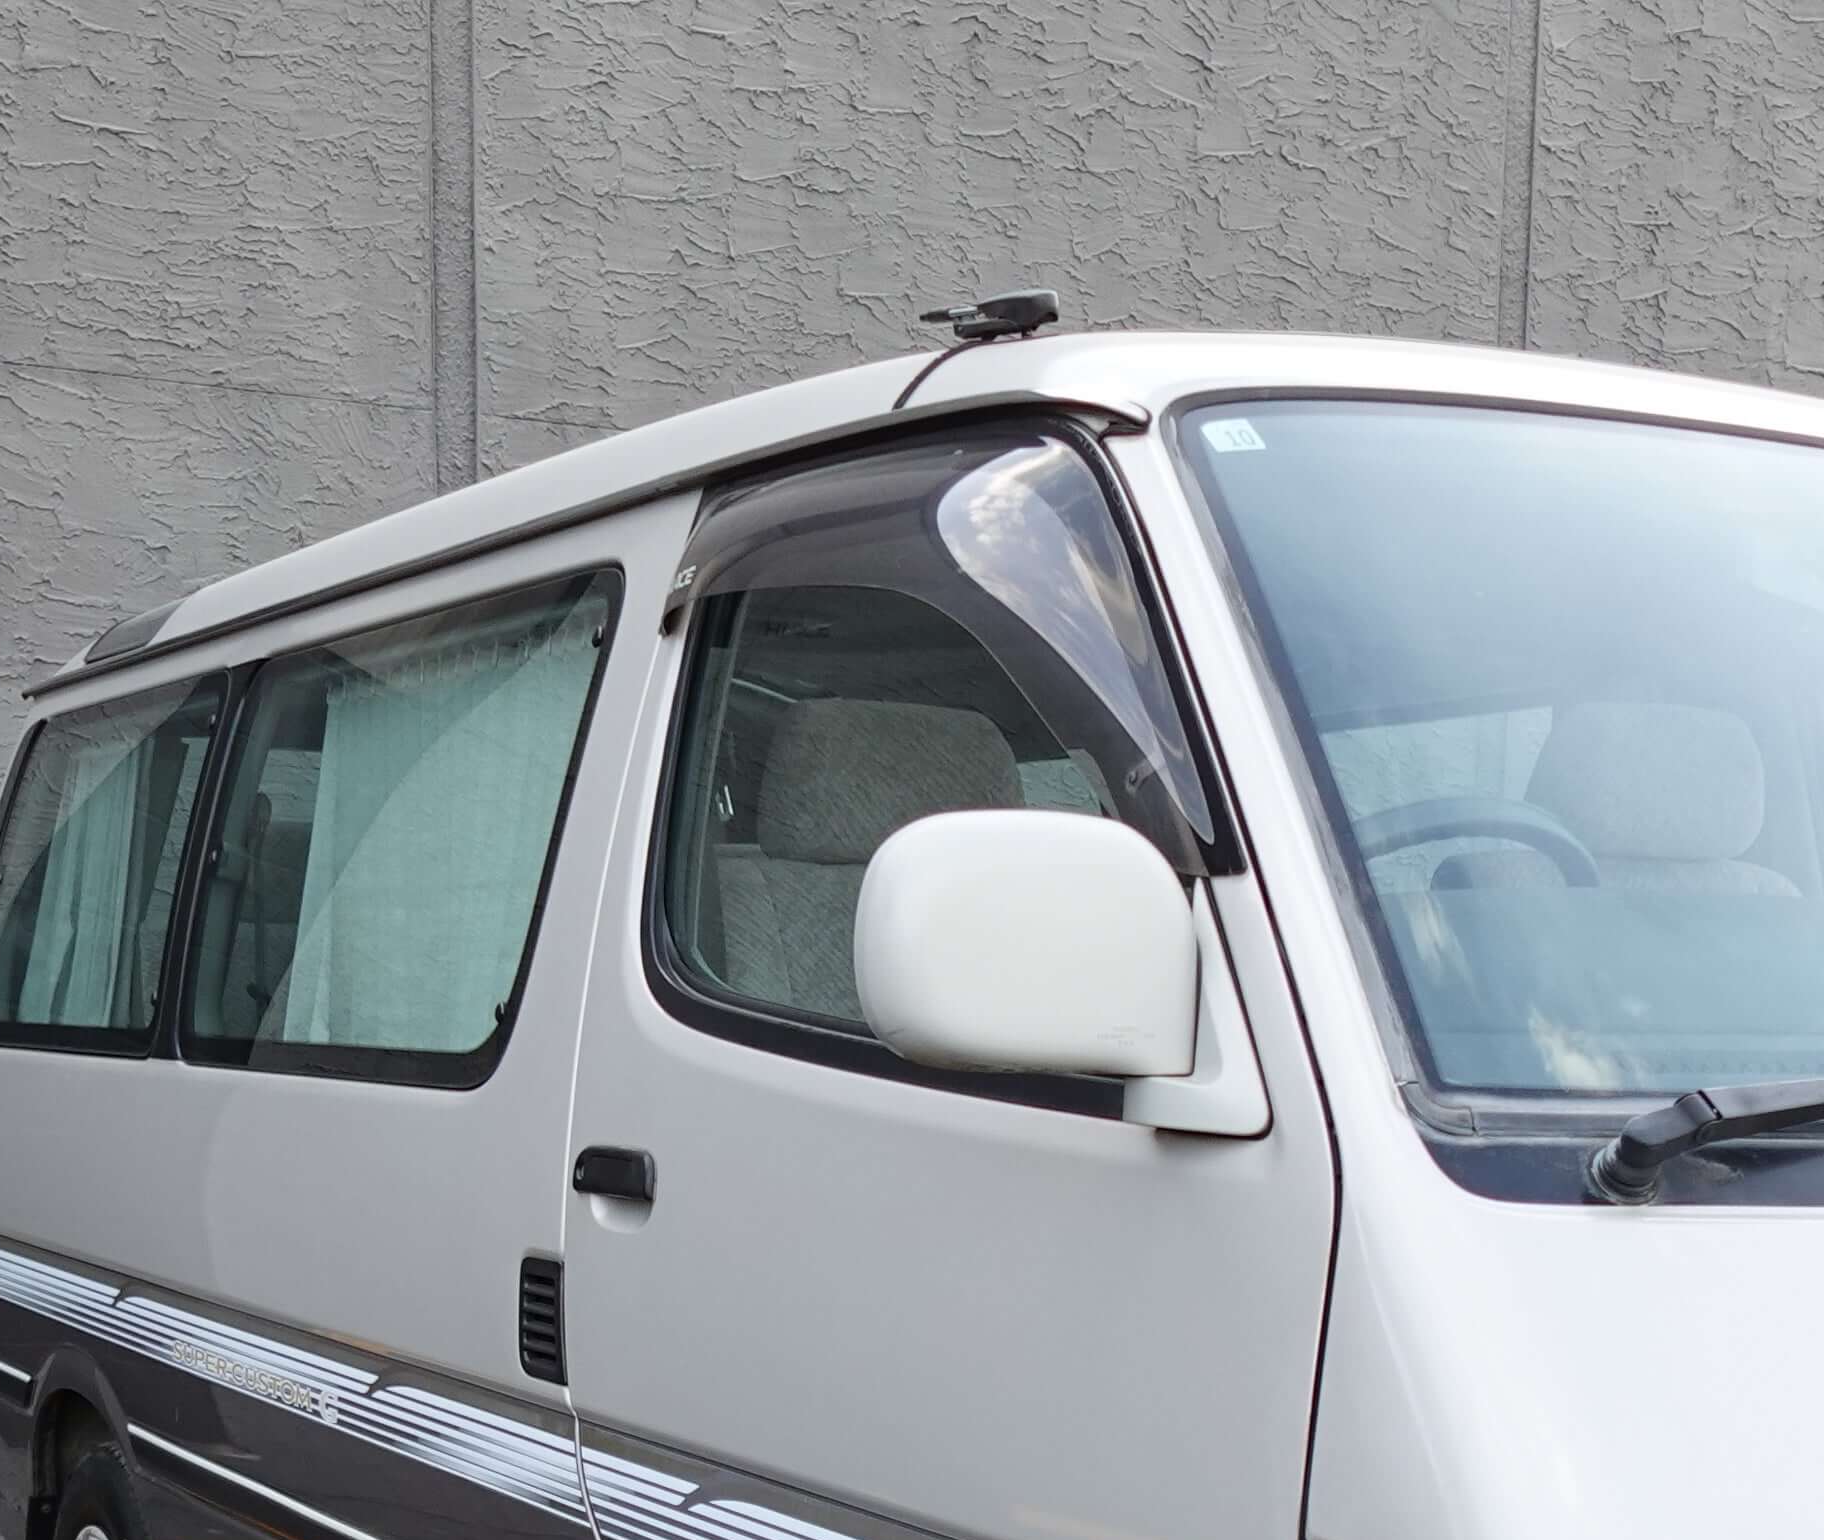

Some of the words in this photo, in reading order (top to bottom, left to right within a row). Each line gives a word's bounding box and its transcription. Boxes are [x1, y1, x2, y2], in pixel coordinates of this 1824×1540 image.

[172, 1340, 227, 1379] SUPER
[231, 1362, 314, 1413] CUSTOM
[319, 1389, 338, 1424] G
